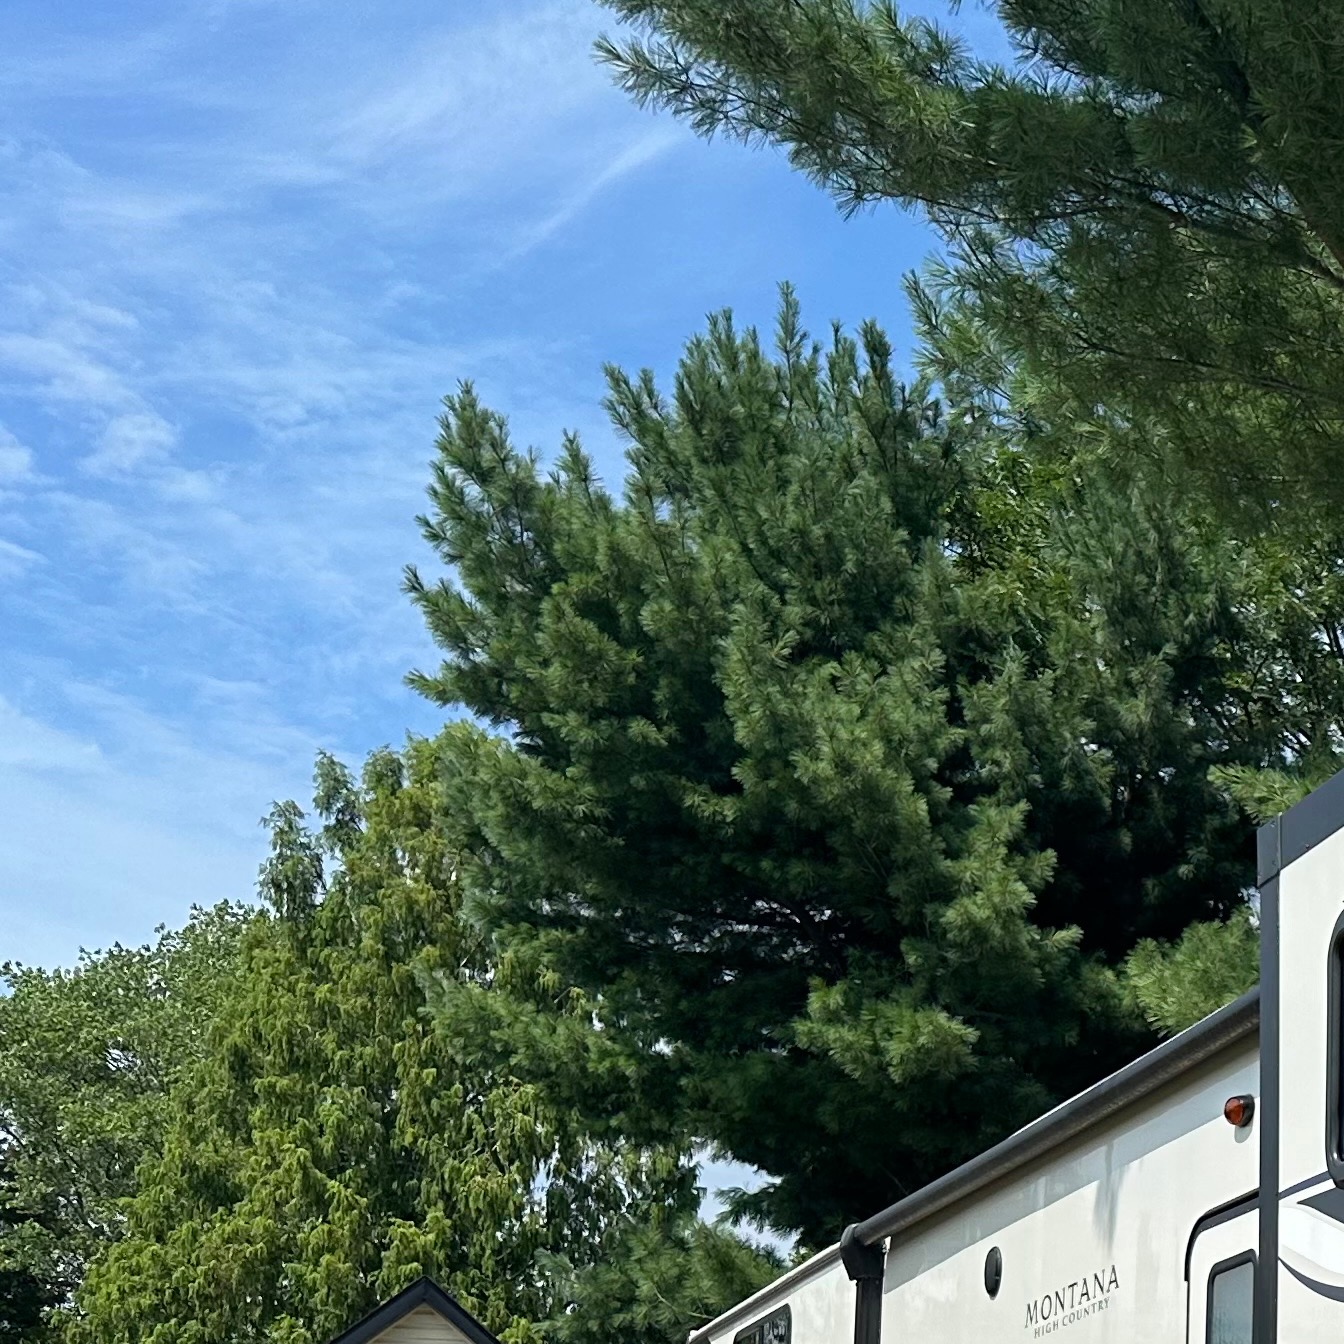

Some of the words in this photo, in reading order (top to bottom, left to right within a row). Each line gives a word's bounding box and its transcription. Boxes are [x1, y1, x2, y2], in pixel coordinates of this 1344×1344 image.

[1025, 1264, 1119, 1328] MONTANA
[1034, 1319, 1060, 1339] HIGH
[1062, 1297, 1110, 1327] COUNTRY
